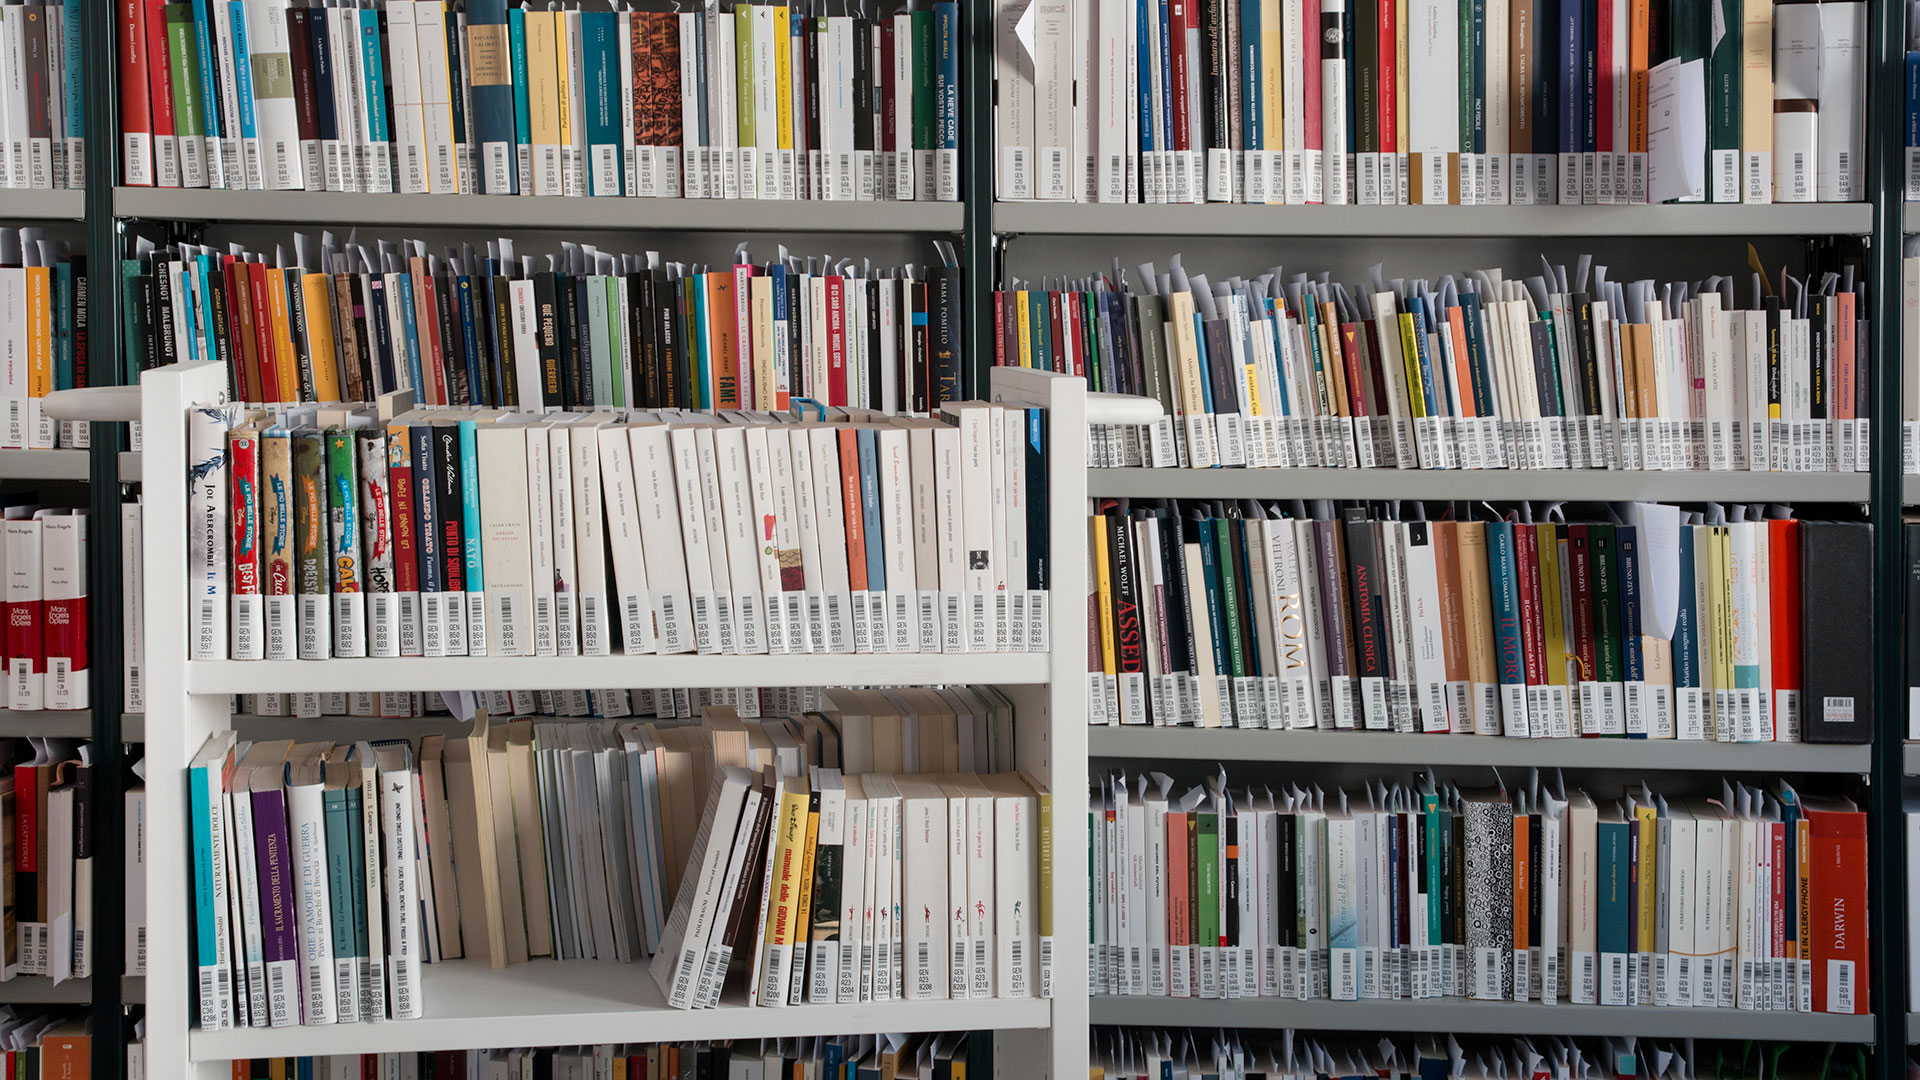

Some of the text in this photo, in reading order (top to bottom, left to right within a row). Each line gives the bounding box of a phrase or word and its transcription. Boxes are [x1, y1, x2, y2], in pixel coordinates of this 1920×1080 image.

[947, 84, 954, 95] LA
[77, 276, 86, 327] CARMEN MOLA
[292, 282, 301, 311] ANTONIO
[831, 296, 840, 310] SARÒ
[940, 278, 948, 304] EMMA
[158, 262, 173, 358] CHESNOT MALBRUNOT
[832, 310, 840, 330] ANCORA
[34, 318, 42, 336] SOGNI
[543, 318, 554, 346] PEQUENO
[1414, 312, 1427, 358] KEN FOLLETT
[832, 334, 841, 351] MIGUEL
[300, 354, 312, 392] Alla fine del
[833, 352, 841, 368] GOTOR
[1187, 358, 1195, 378] Abitare
[720, 376, 736, 404] FAME
[1190, 387, 1198, 411] bellezza
[420, 435, 428, 450] Sofia
[276, 482, 284, 492] LE
[374, 488, 381, 496] LE
[236, 507, 246, 526] Disney
[268, 506, 277, 524] Disney
[368, 512, 377, 530] Disney
[398, 478, 410, 550] LA NONNA IN FUGA
[422, 478, 433, 554] ORLANDO TISATO
[278, 524, 286, 548] STORIE
[446, 520, 458, 546] PUNTO
[447, 548, 458, 557] DI
[466, 538, 477, 568] NATO
[1116, 526, 1129, 596] MICHAEL WOLFF
[1272, 535, 1285, 591] VELTRONI
[1286, 540, 1298, 584] WALTER
[238, 562, 254, 584] BEST
[1502, 577, 1510, 612] LOMARTIRE
[11, 612, 31, 620] Engels
[1356, 565, 1376, 672] ANATOMIA CLINICA
[1501, 617, 1514, 631] IL
[1117, 598, 1141, 673] ASSED
[1278, 592, 1307, 670] ROM
[211, 804, 223, 898] NATURALMENTE DOLCE
[268, 833, 279, 865] PENITENZA
[302, 822, 312, 862] GUERRA
[270, 866, 280, 885] DELLA
[304, 866, 312, 877] DI
[310, 860, 321, 887] Brescia
[782, 848, 792, 882] manuale
[272, 886, 284, 924] SACRAMENTO
[312, 889, 321, 898] di
[780, 884, 790, 902] delle
[306, 889, 316, 934] D'AMORE
[314, 899, 322, 925] Ronchi
[1800, 877, 1809, 936] CLERGYPHONE
[216, 916, 225, 936] Susini
[775, 906, 788, 936] GIOVANI
[1834, 898, 1846, 950] DARWIN
[317, 937, 326, 958] Piave
